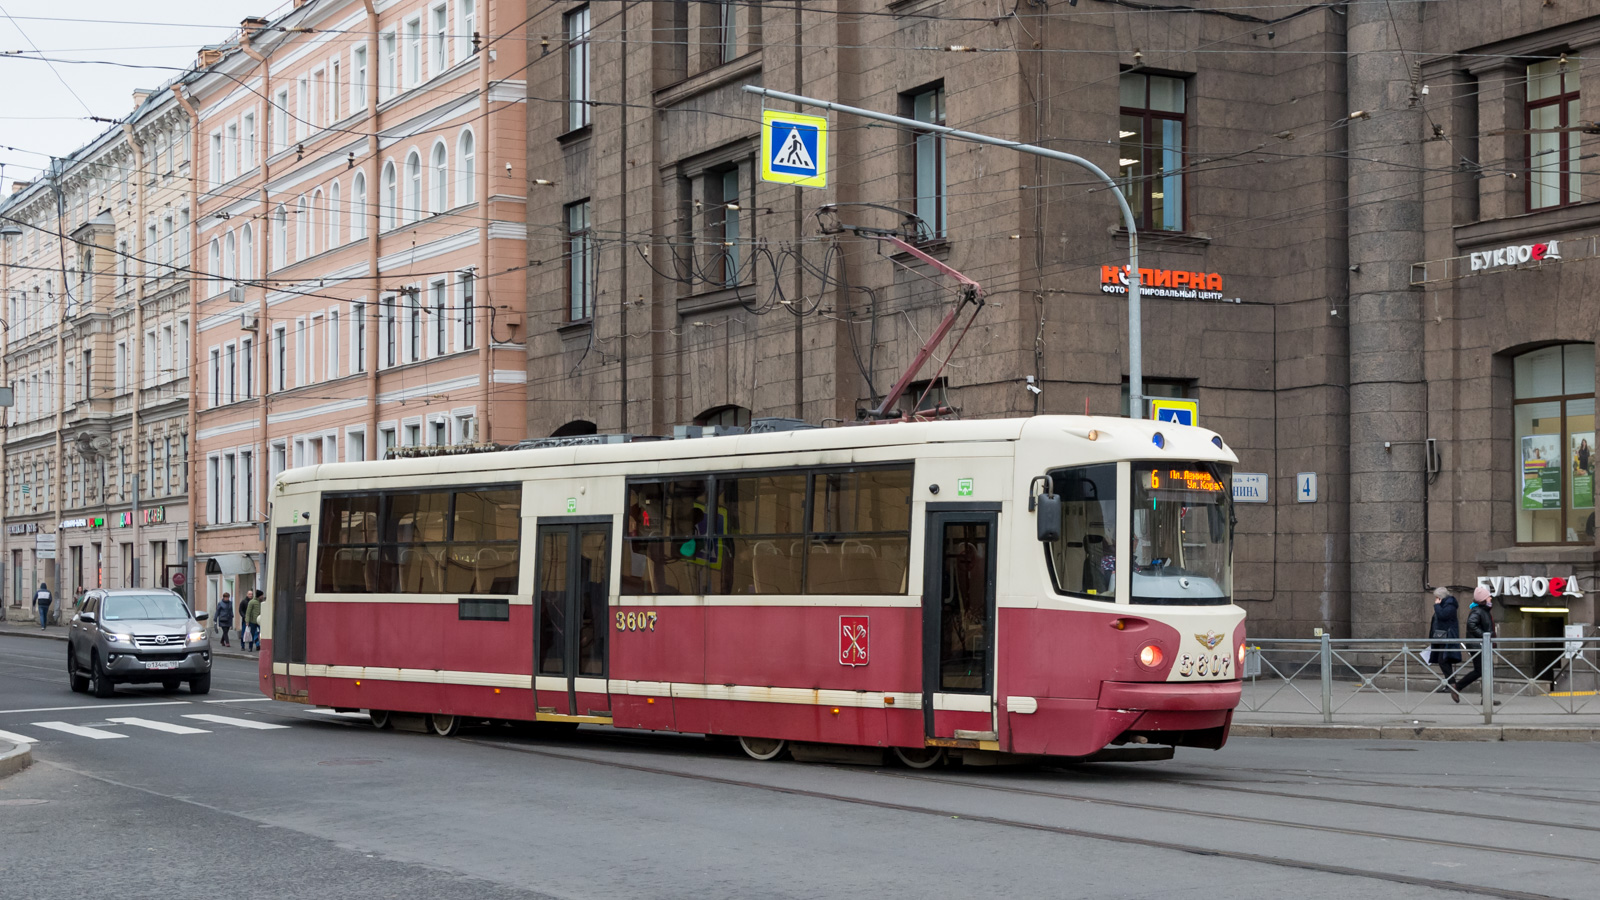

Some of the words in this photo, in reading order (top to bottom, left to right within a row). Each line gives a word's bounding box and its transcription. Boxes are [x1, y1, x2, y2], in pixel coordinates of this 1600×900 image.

[1139, 287, 1197, 299] ПИРОВАЛЬНЫЙ
[1198, 291, 1223, 300] ЦЕНТР
[1151, 469, 1160, 489] 6
[1183, 470, 1211, 481] Ленина
[1232, 486, 1259, 497] НИНА
[1302, 477, 1311, 497] 4
[616, 611, 657, 632] 3607
[1179, 652, 1231, 678] 3607
